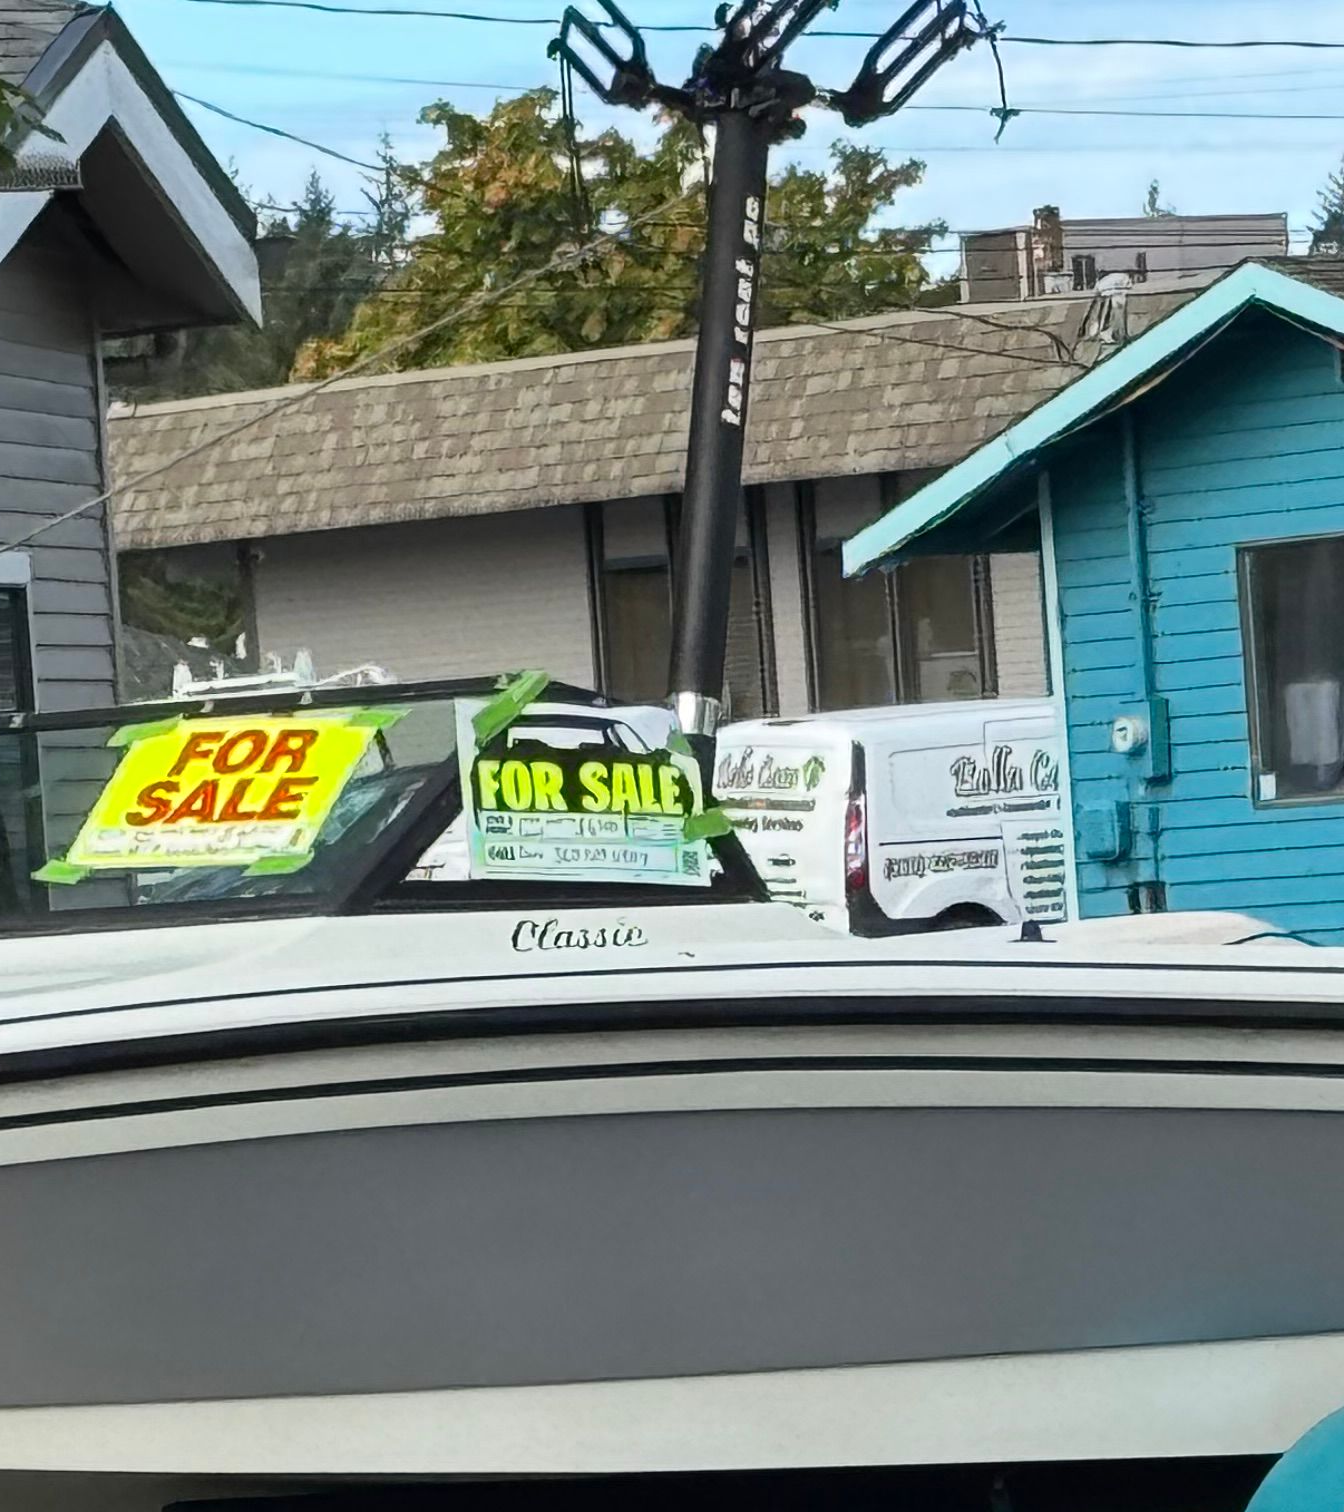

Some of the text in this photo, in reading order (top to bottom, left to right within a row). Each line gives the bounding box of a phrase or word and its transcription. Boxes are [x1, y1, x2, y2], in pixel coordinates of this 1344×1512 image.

[167, 729, 319, 777] FOR
[126, 776, 319, 826] SALE
[477, 760, 568, 811] FOR
[579, 761, 684, 814] SALE
[512, 917, 649, 952] Classic
